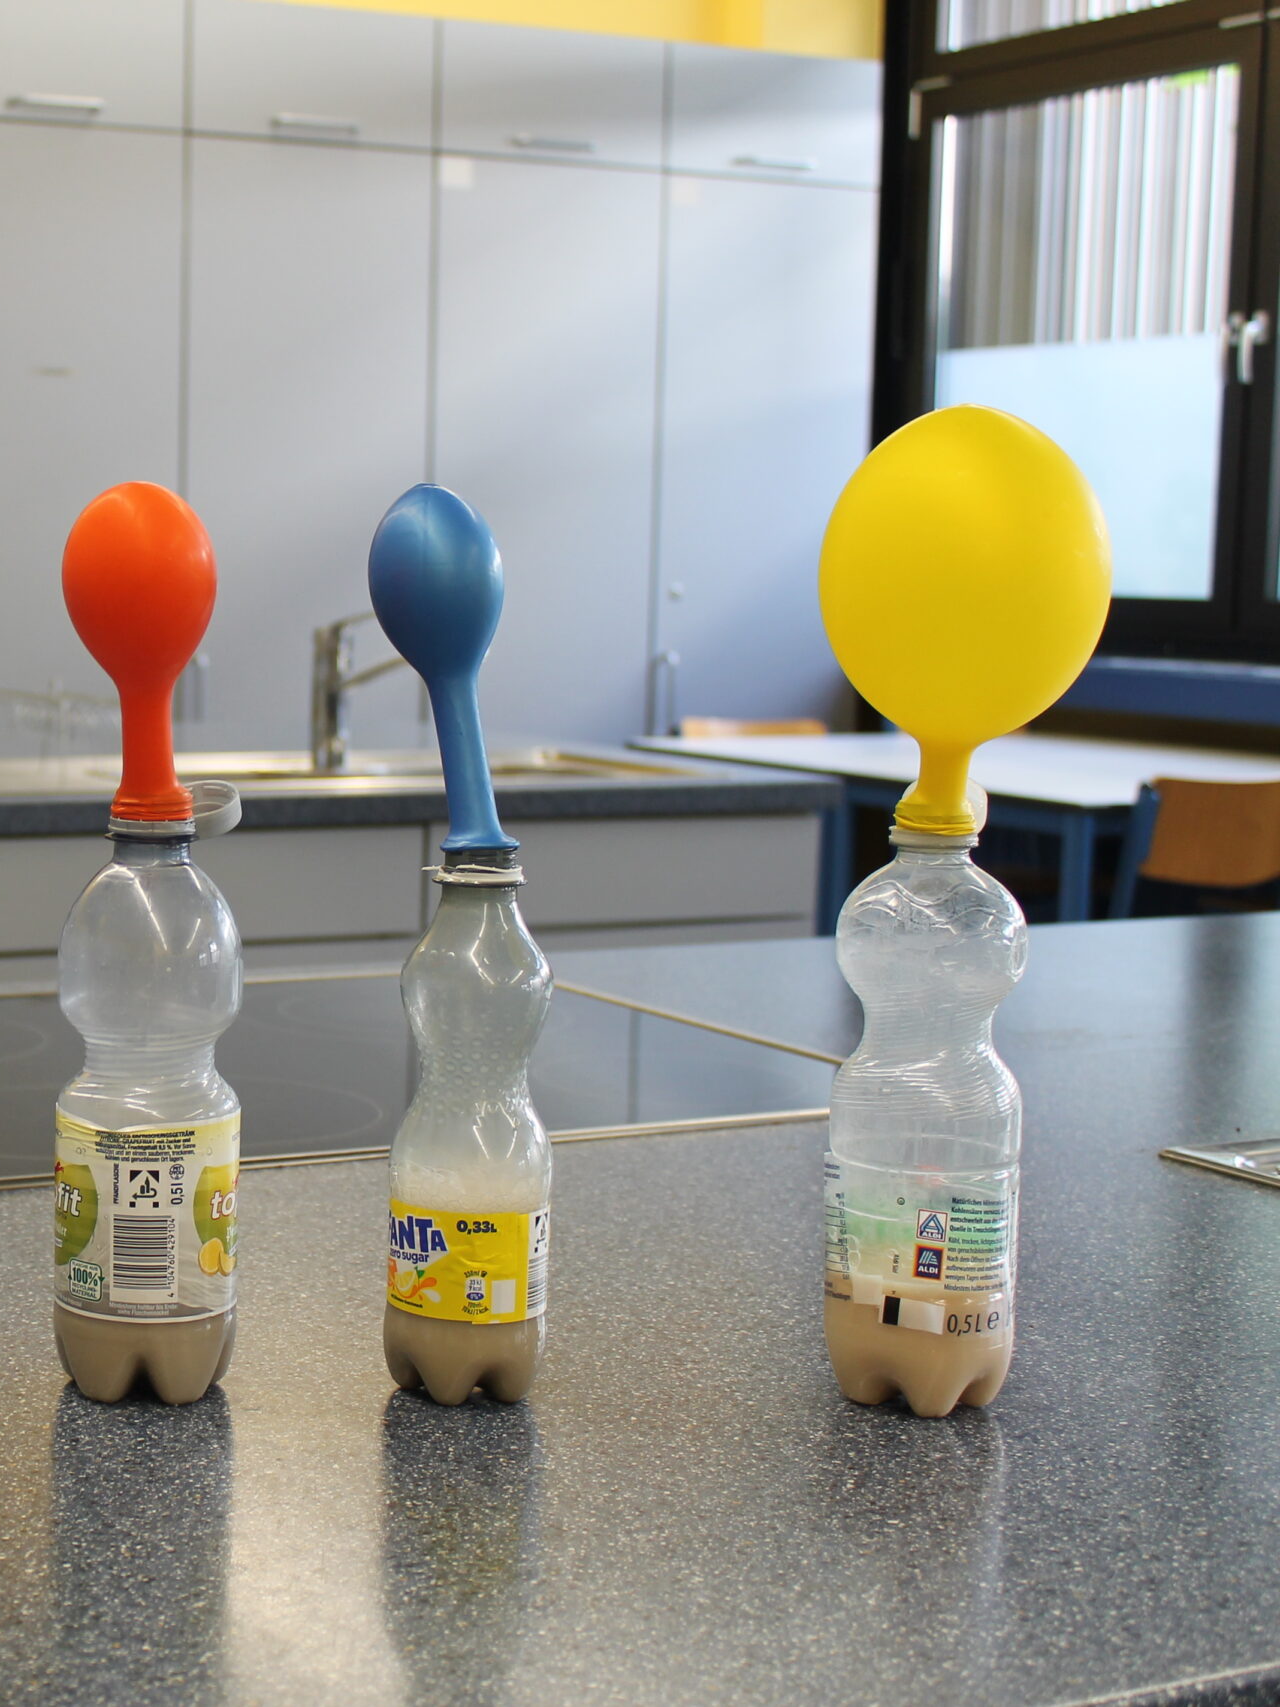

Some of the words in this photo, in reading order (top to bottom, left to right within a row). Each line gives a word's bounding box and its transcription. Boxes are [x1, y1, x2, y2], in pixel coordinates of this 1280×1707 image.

[55, 1181, 82, 1218] fit
[921, 1231, 941, 1240] ALDI
[402, 1250, 430, 1265] sugar
[72, 1266, 98, 1287] 100%
[918, 1265, 938, 1275] ALDI
[947, 1313, 973, 1337] 0,5
